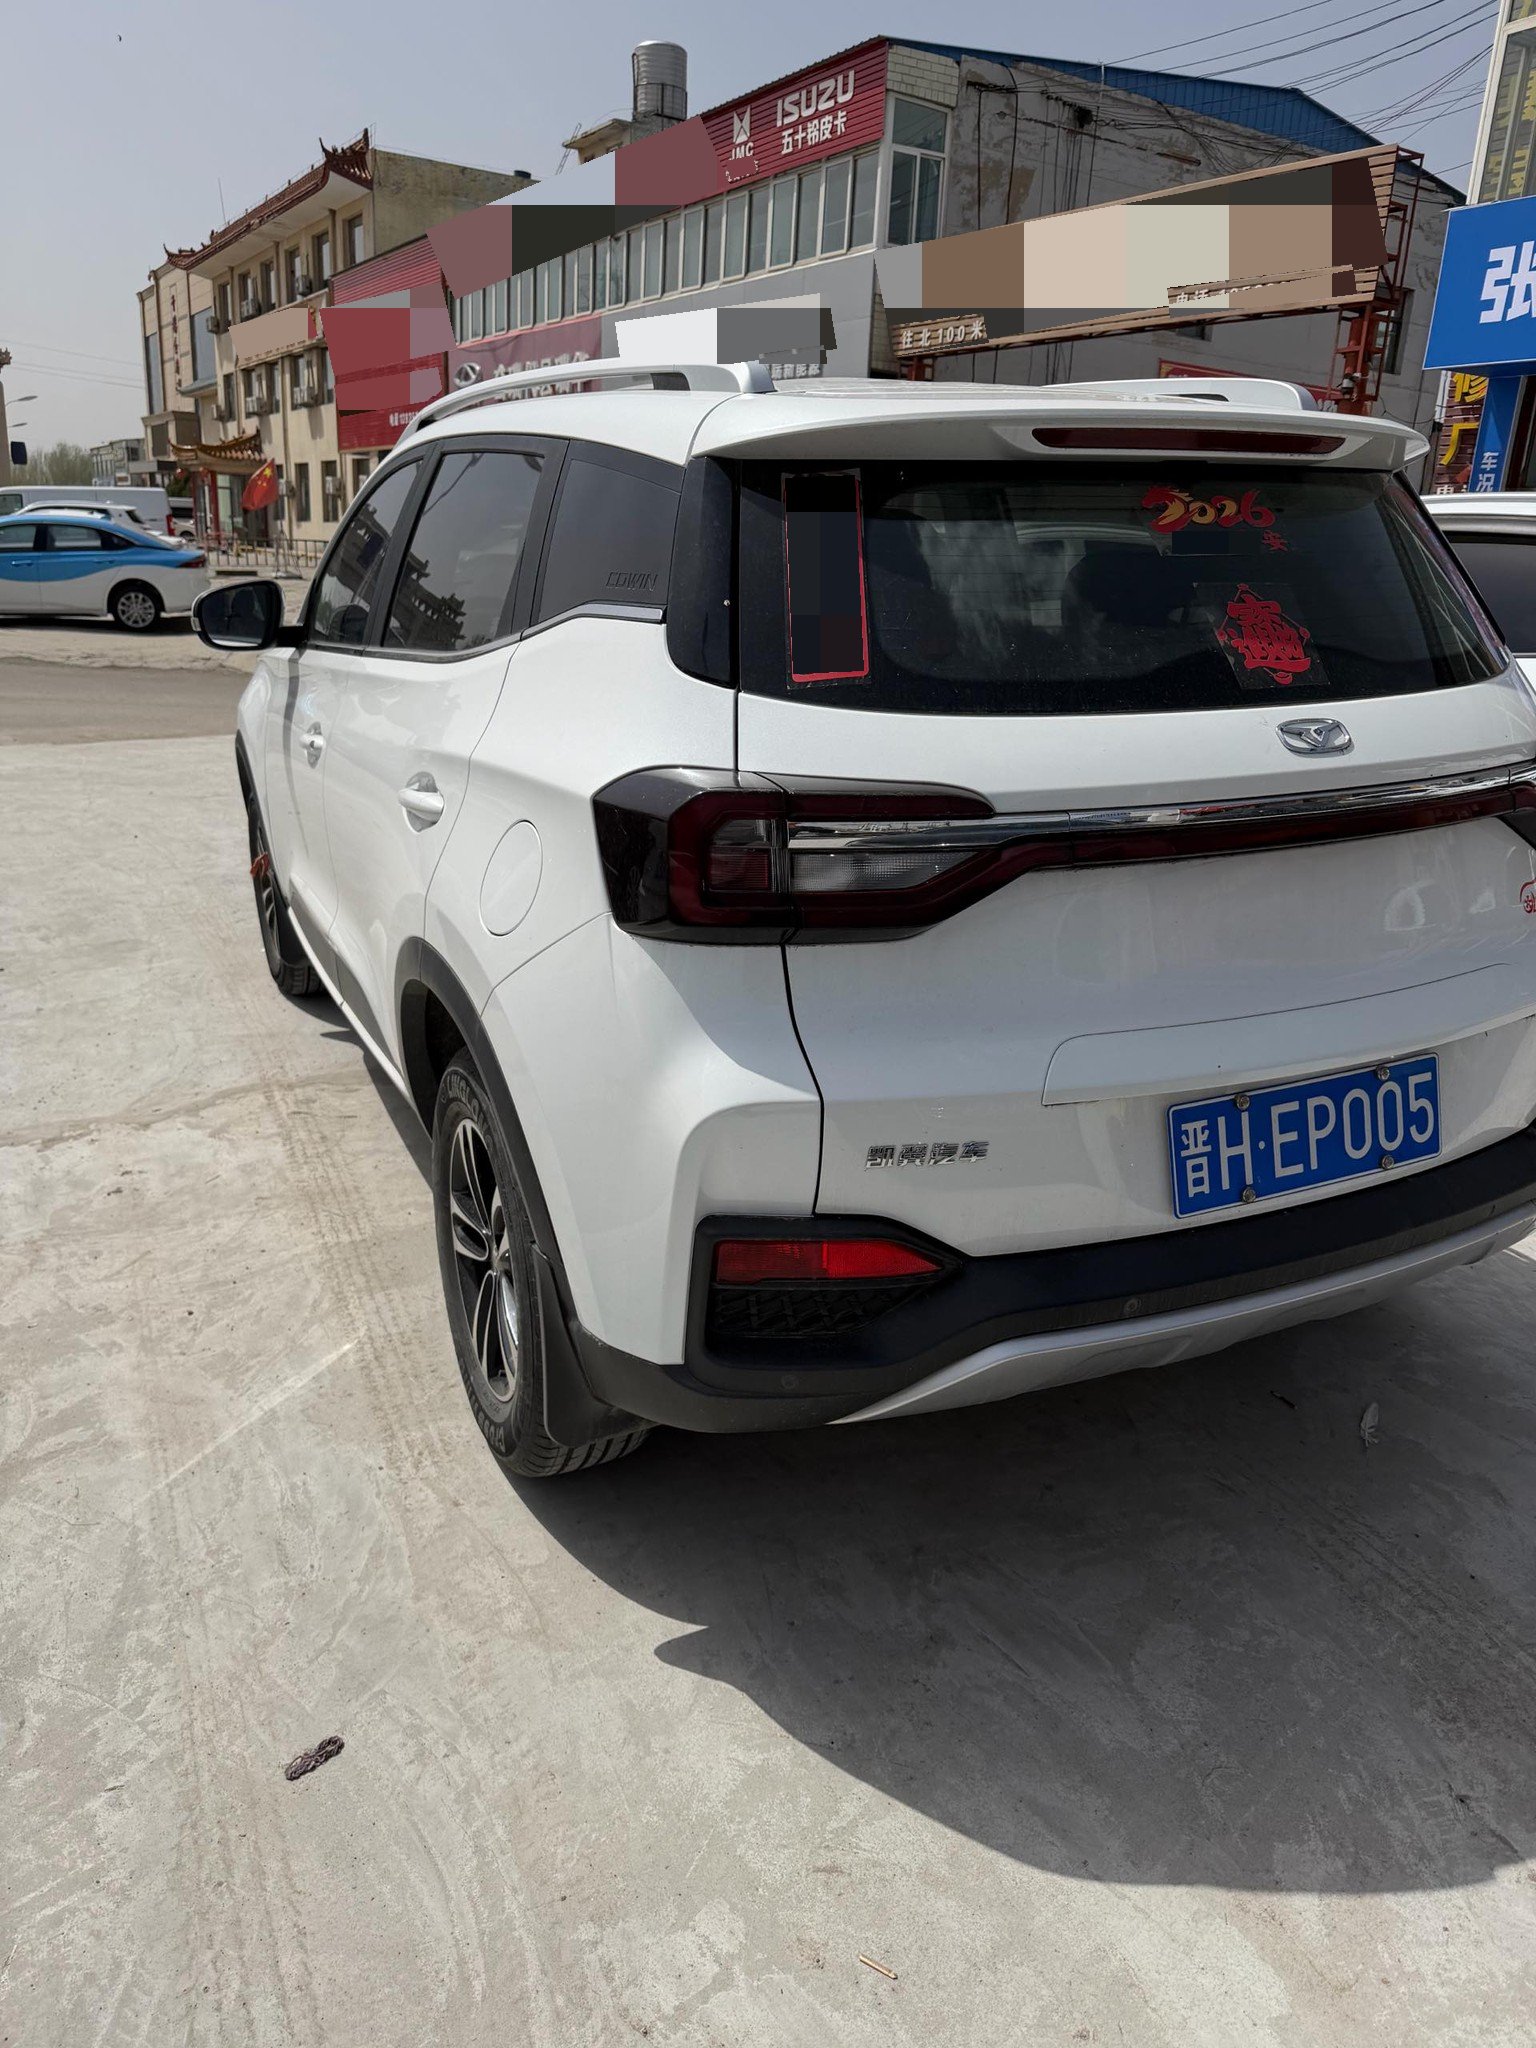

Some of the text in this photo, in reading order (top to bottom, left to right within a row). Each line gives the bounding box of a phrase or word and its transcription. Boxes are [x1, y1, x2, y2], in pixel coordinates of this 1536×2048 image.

[776, 70, 855, 127] ISUZU
[781, 110, 847, 154] 五十铃皮卡
[902, 320, 983, 348] 往北100米
[865, 1141, 990, 1168] 凯翼汽车
